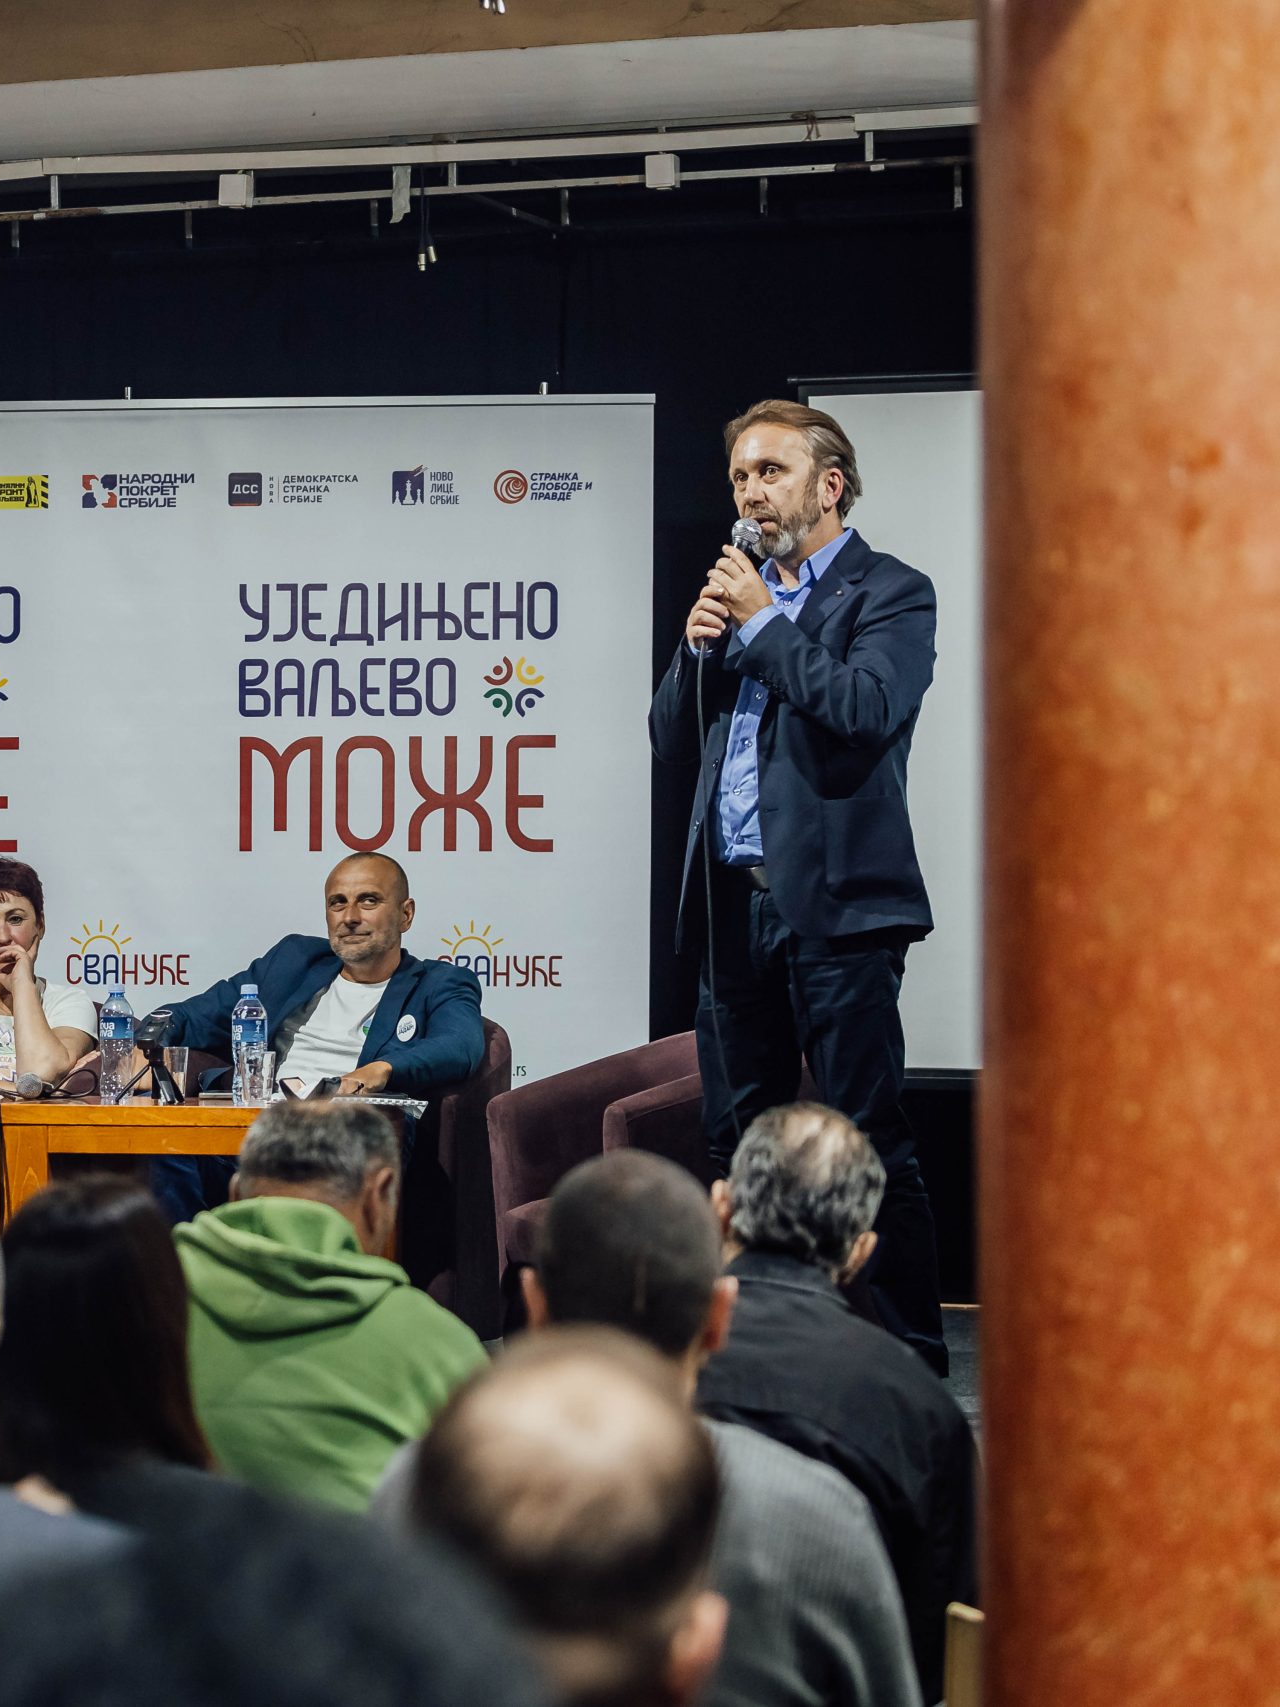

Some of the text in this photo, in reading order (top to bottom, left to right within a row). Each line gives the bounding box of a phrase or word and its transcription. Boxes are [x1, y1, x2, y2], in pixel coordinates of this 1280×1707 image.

[119, 473, 195, 485] НАРОДНИ
[283, 475, 359, 484] ДЕМОКРАТСКА
[430, 471, 453, 481] НОВО
[530, 472, 579, 481] СТРАНКА
[119, 485, 179, 496] ПОКРЕТ
[232, 484, 259, 494] ДСС
[283, 485, 330, 493] СТРАНКА
[430, 483, 454, 494] ЛИЦЕ
[530, 482, 593, 492] СЛОБОДЕ И
[283, 495, 323, 503] СРБИЈЕ
[430, 495, 460, 505] СРБИЈЕ
[530, 492, 572, 502] ПРАВДЕ
[119, 497, 177, 508] СРБИЈЕ
[239, 581, 558, 646] УЈЕДИЊЕНО
[238, 657, 456, 717] ВАЉЕВО
[239, 734, 556, 852] МОЖЕ
[66, 953, 190, 986] СВАНУЋЕ
[437, 955, 563, 987] АНУЋЕ
